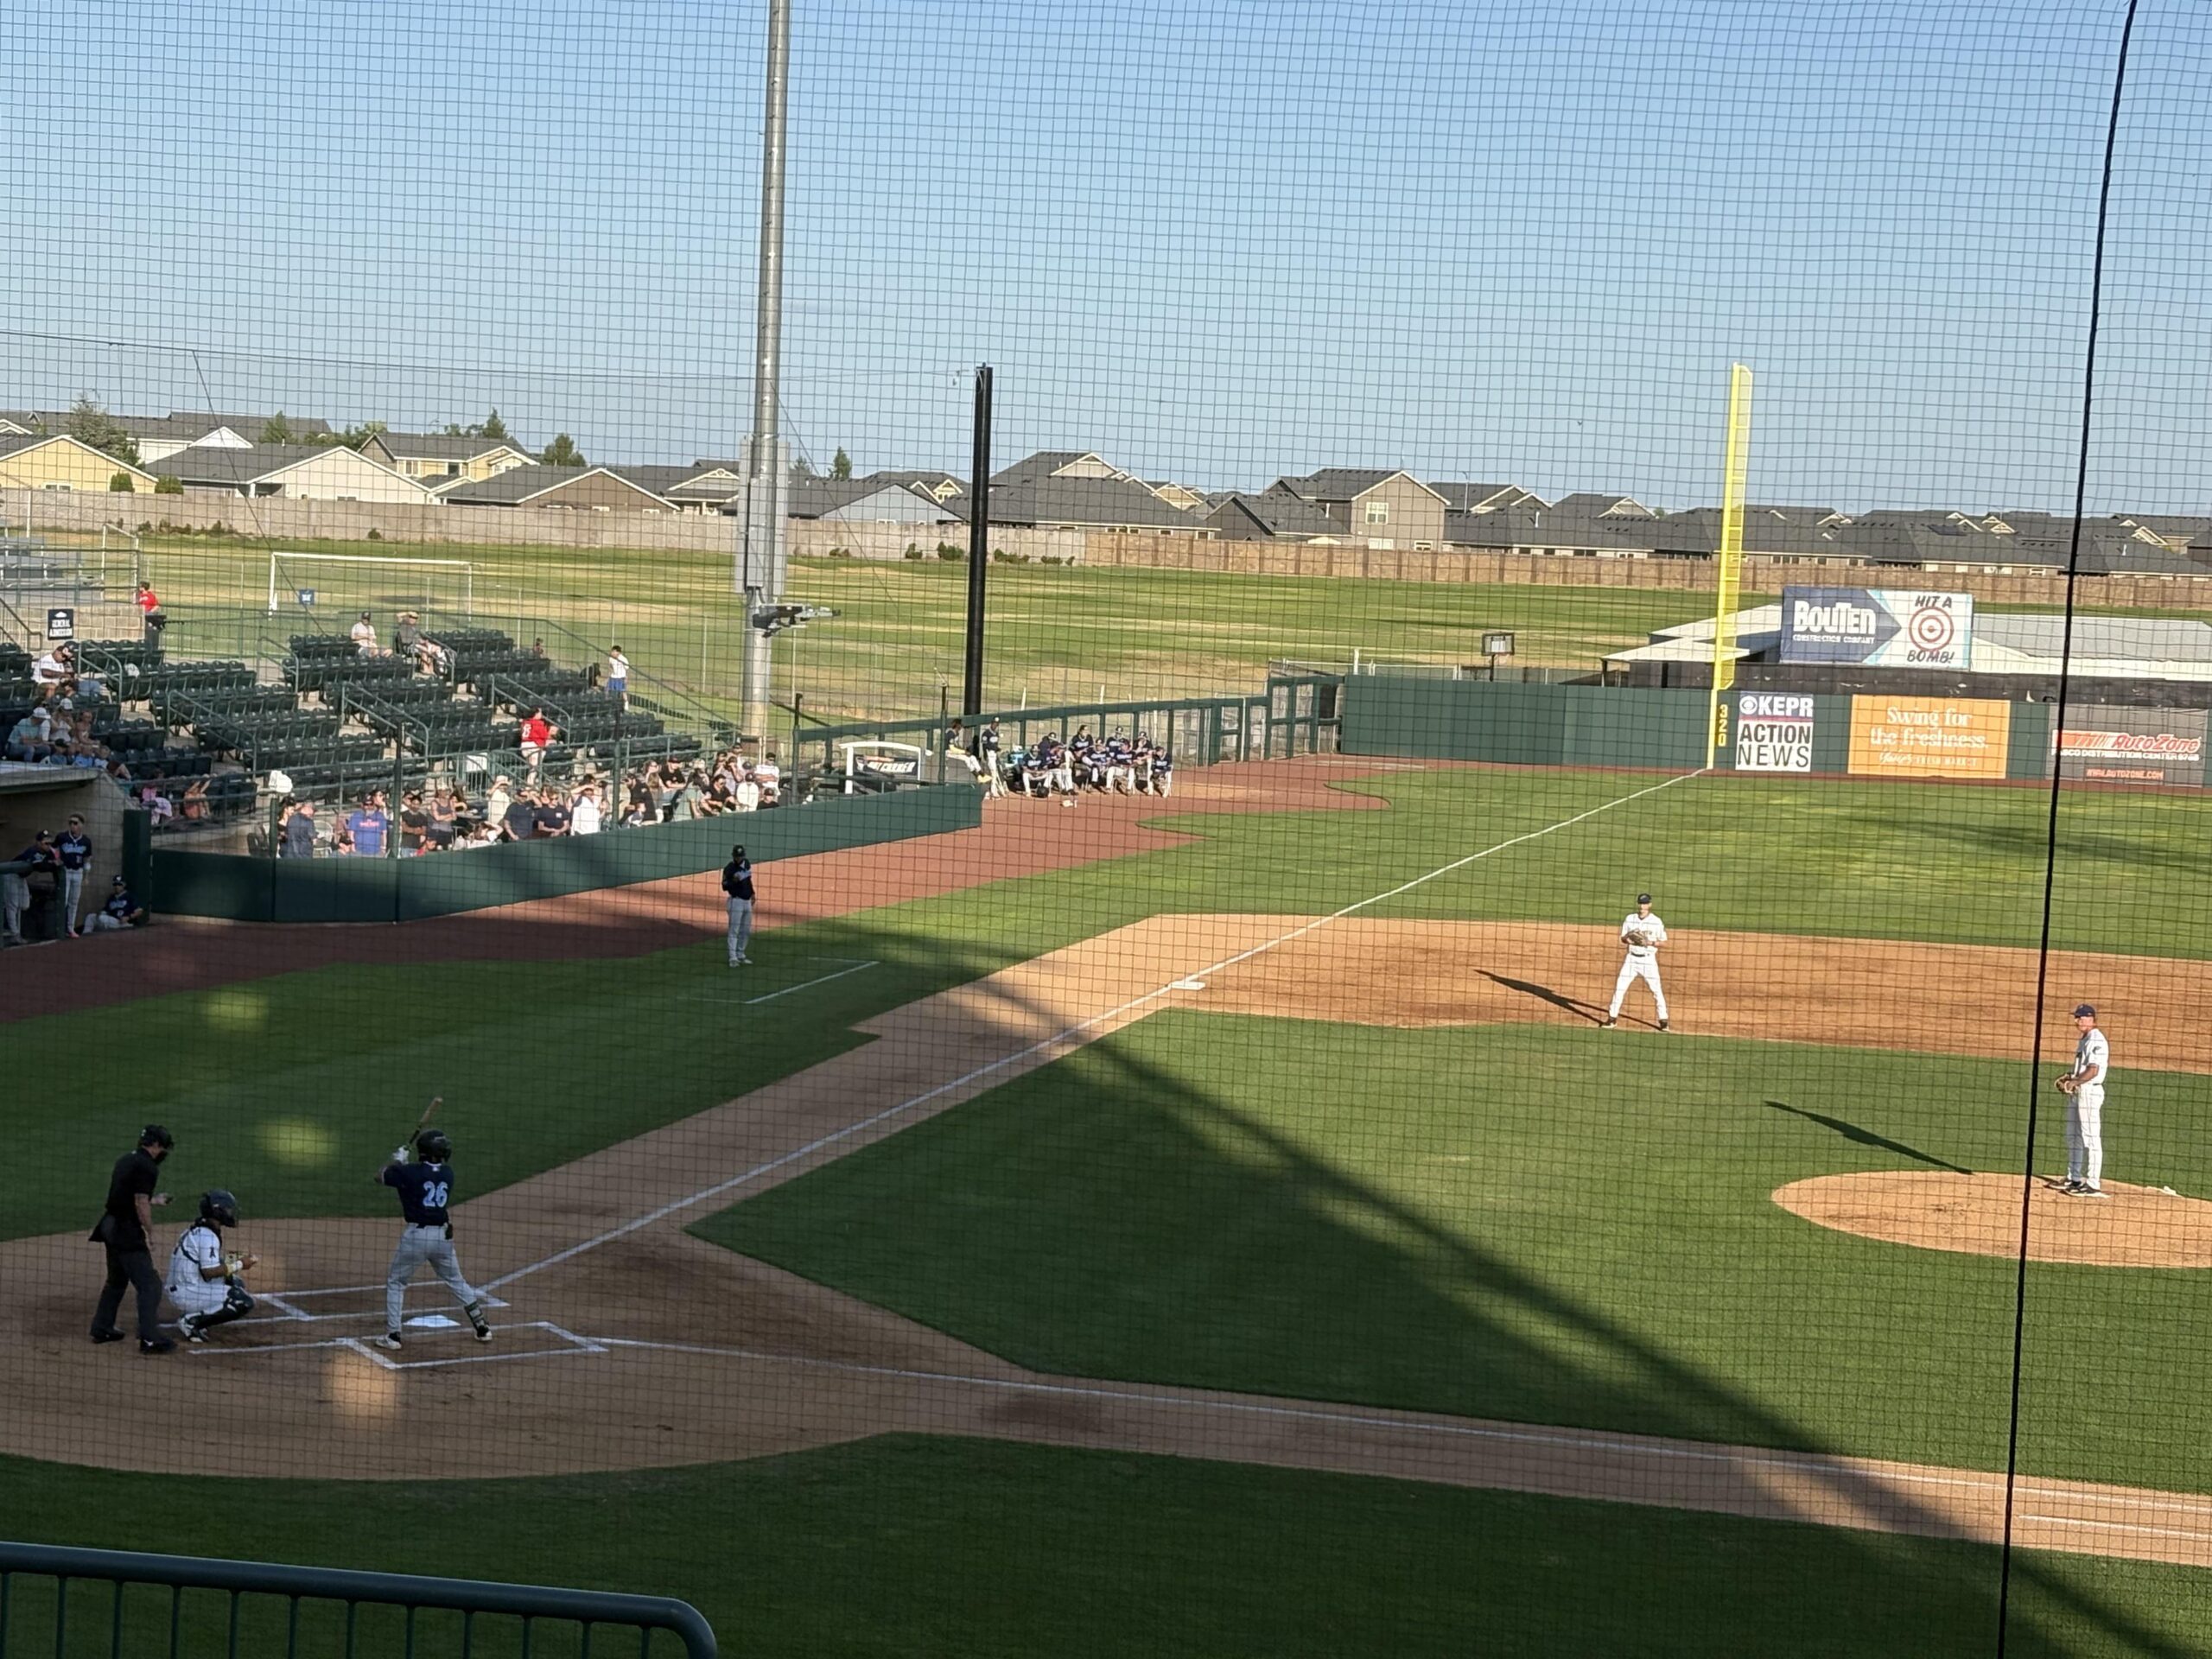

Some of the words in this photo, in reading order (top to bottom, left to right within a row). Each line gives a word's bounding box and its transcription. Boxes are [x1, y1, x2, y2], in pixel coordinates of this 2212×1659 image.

[1915, 595, 1940, 607] HIT
[1942, 596, 1953, 608] A
[1907, 650, 1955, 664] BOMB!
[1758, 696, 1814, 718] KEPR
[1886, 706, 1940, 730] Swing
[1944, 707, 1973, 727] for
[1718, 704, 1728, 747] 320
[1739, 723, 1811, 744] ACTION
[1870, 727, 1897, 746] the
[1902, 728, 1989, 749] freshness.
[2111, 733, 2200, 753] AutoZone
[1737, 744, 1809, 768] NEWS
[2142, 752, 2177, 760] CENTER
[423, 1180, 448, 1207] 26
